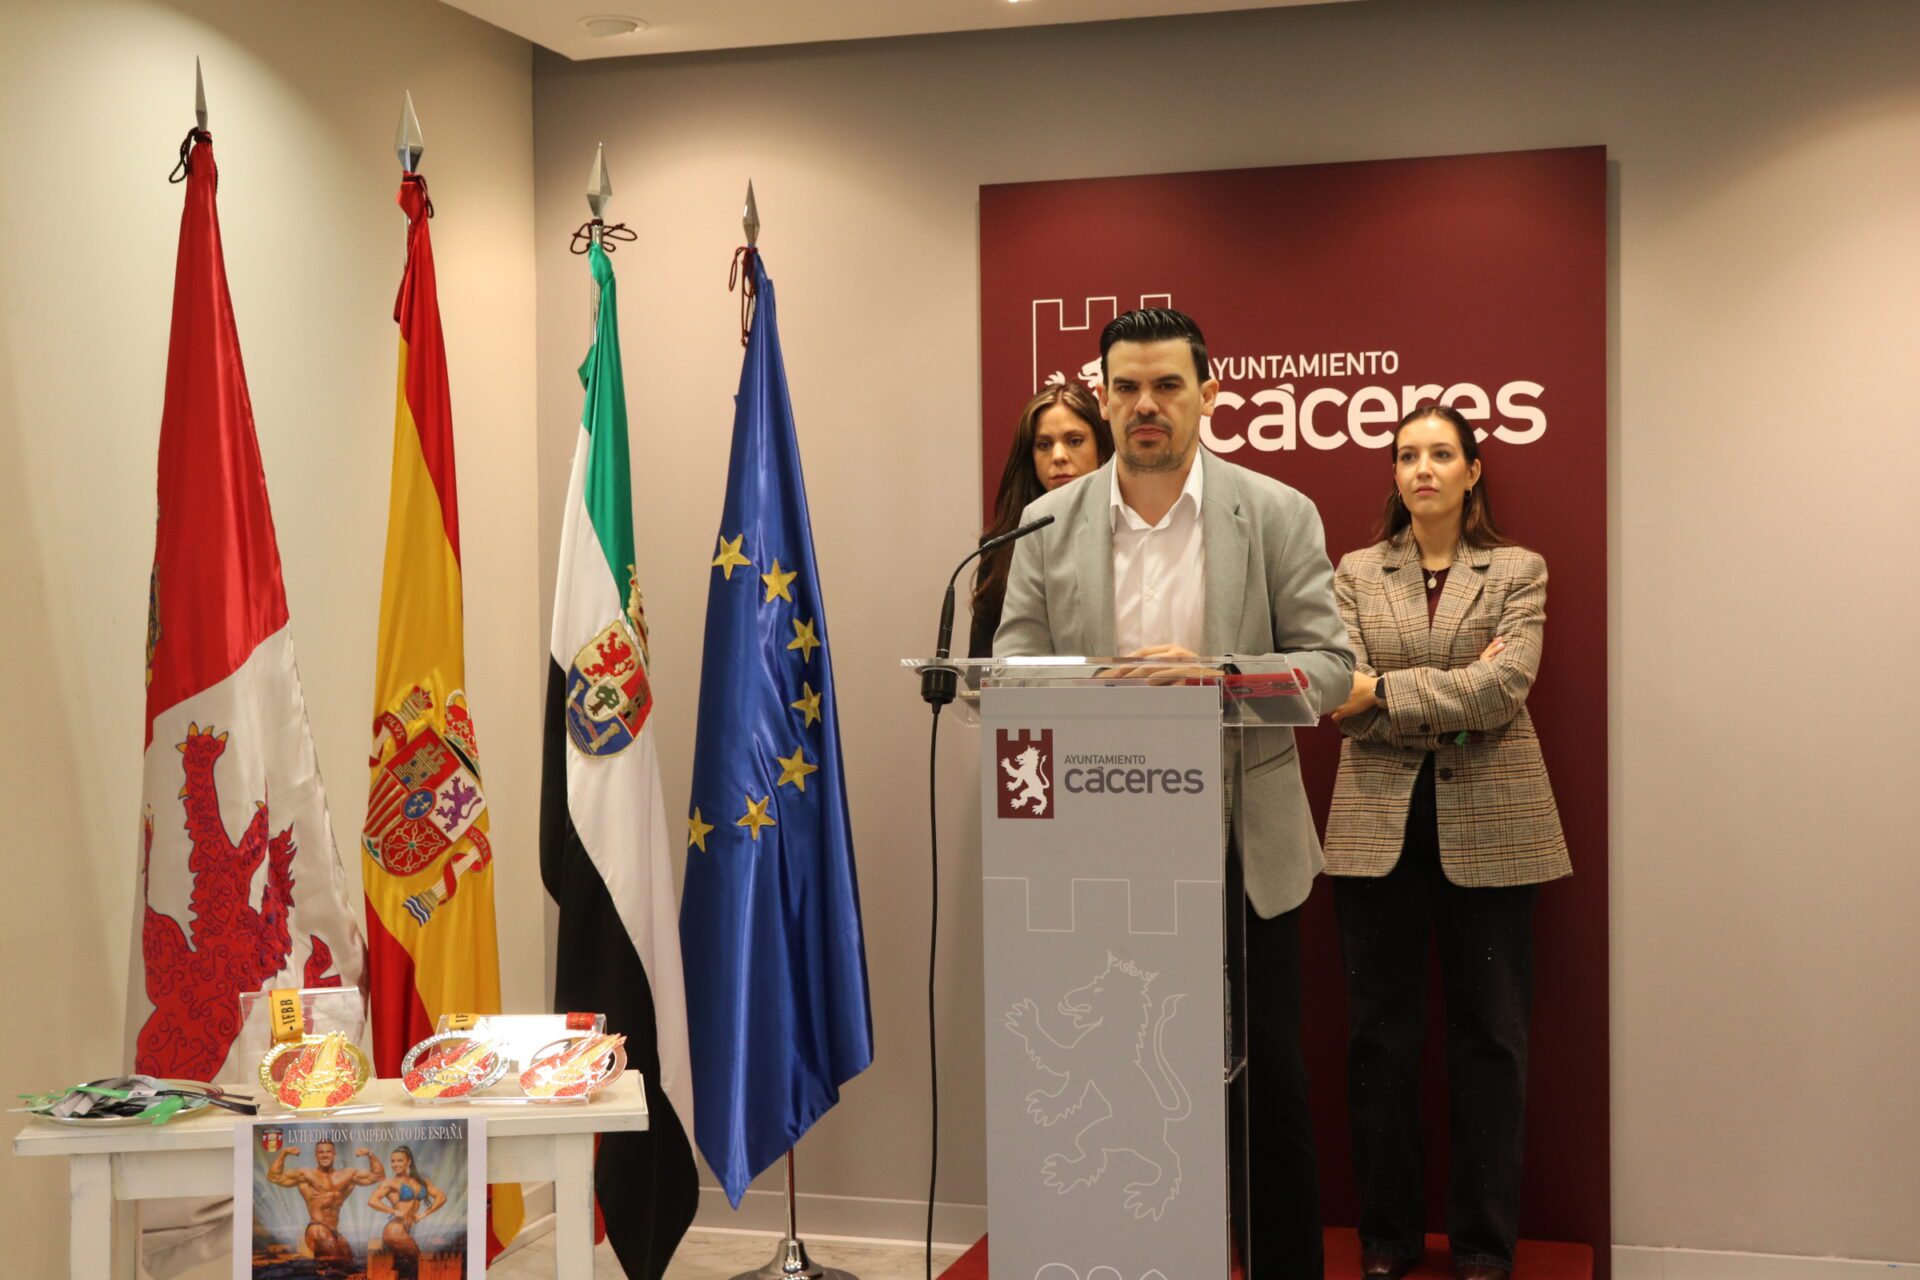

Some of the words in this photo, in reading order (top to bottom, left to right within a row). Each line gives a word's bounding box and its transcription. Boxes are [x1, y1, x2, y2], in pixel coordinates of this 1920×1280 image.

[1198, 380, 1547, 454] cáceres
[1064, 754, 1146, 765] AYUNTAMIENTO
[1064, 766, 1205, 794] cáceres
[280, 999, 295, 1025] IFBB
[350, 1126, 412, 1142] CAMPEONATO
[414, 1126, 427, 1141] DE
[428, 1122, 463, 1141] ESPAÑA
